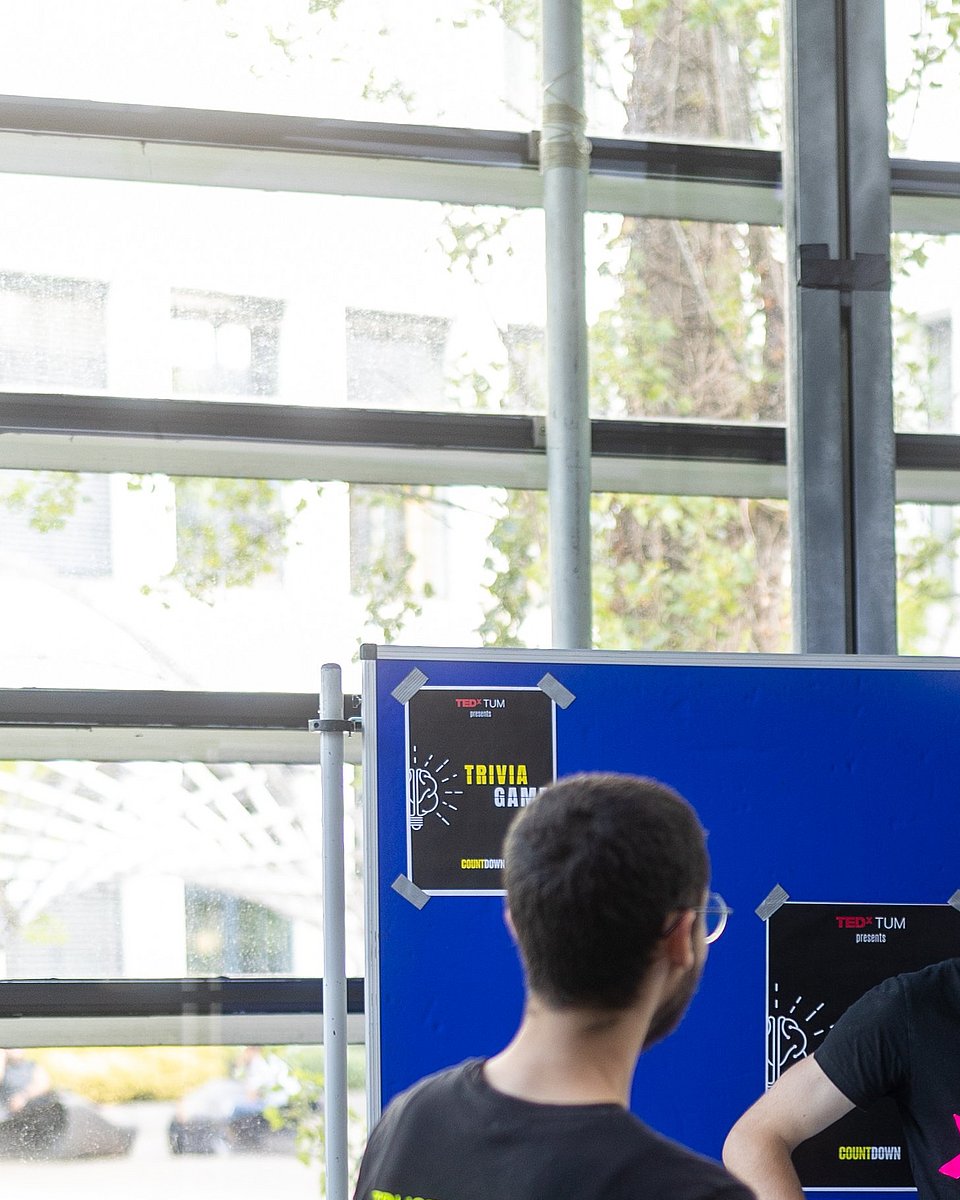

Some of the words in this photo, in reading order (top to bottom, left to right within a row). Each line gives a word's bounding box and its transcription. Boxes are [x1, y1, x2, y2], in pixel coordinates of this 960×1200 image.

[464, 765, 528, 785] TRIVIA
[494, 787, 548, 807] GAM
[856, 933, 887, 944] presents
[839, 1146, 901, 1160] COUNTDOWN
